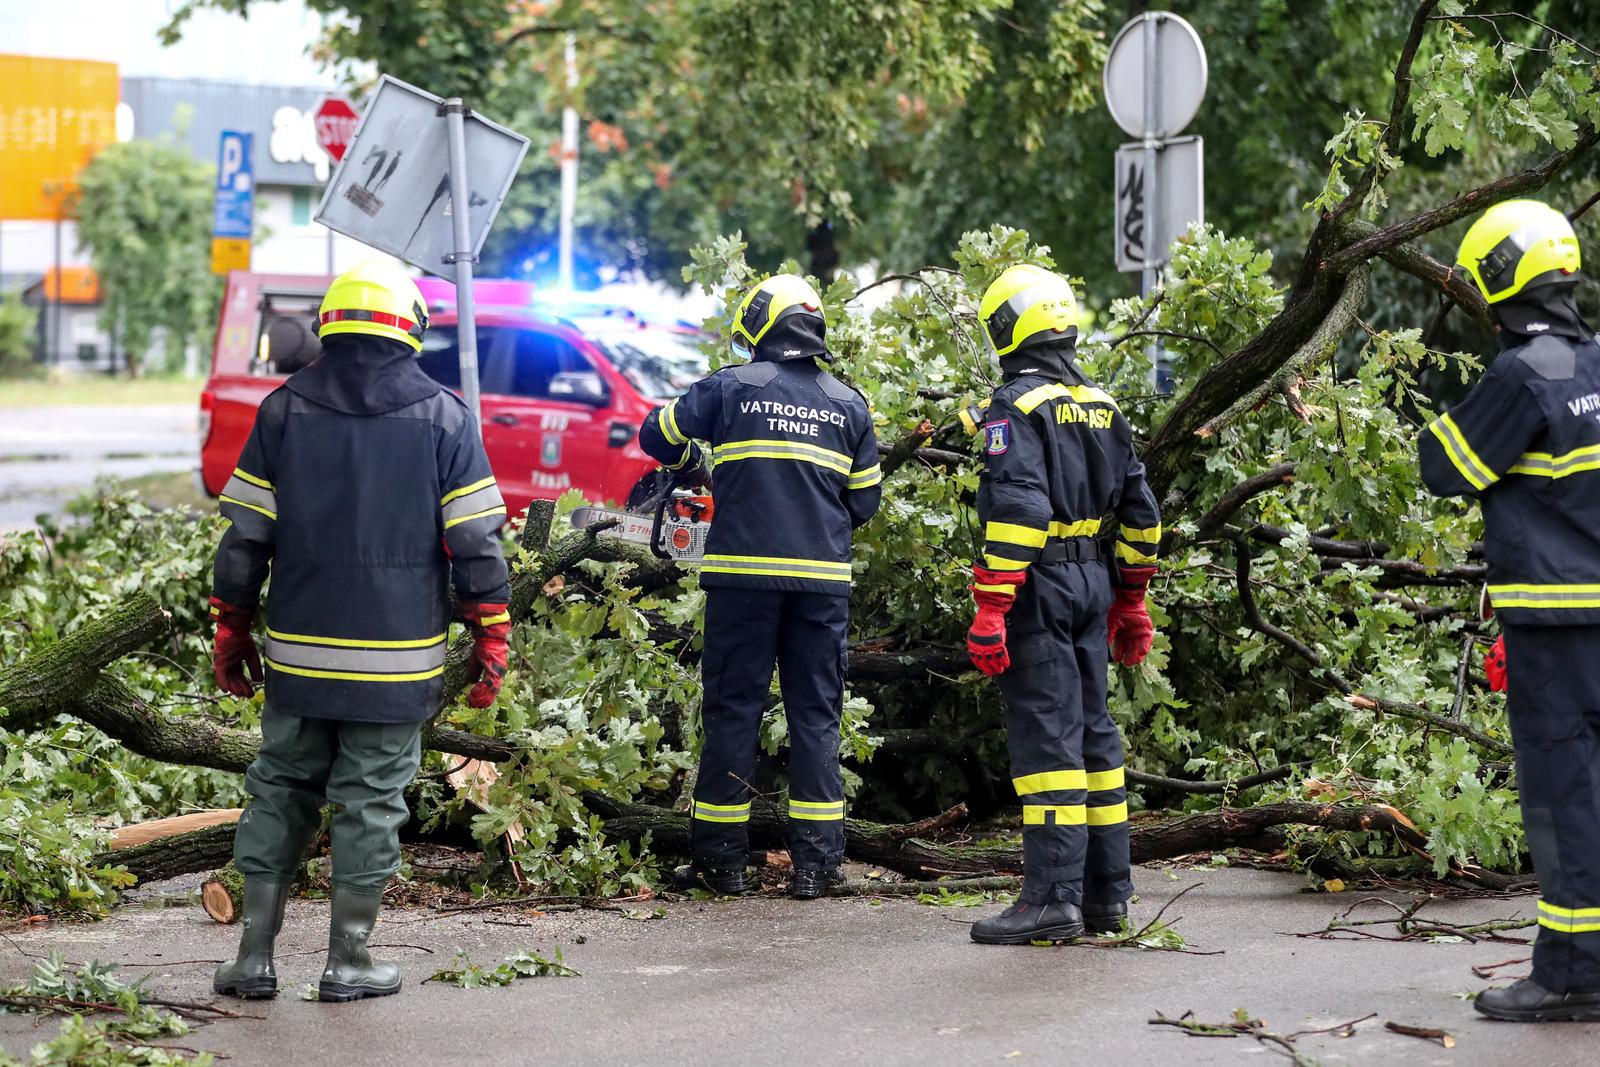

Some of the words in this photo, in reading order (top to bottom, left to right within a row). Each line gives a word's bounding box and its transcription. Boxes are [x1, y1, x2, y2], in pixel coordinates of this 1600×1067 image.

[221, 137, 242, 187] P
[740, 400, 846, 428] VATROGASCI
[767, 418, 819, 437] TRNJE
[629, 524, 652, 536] STIH
